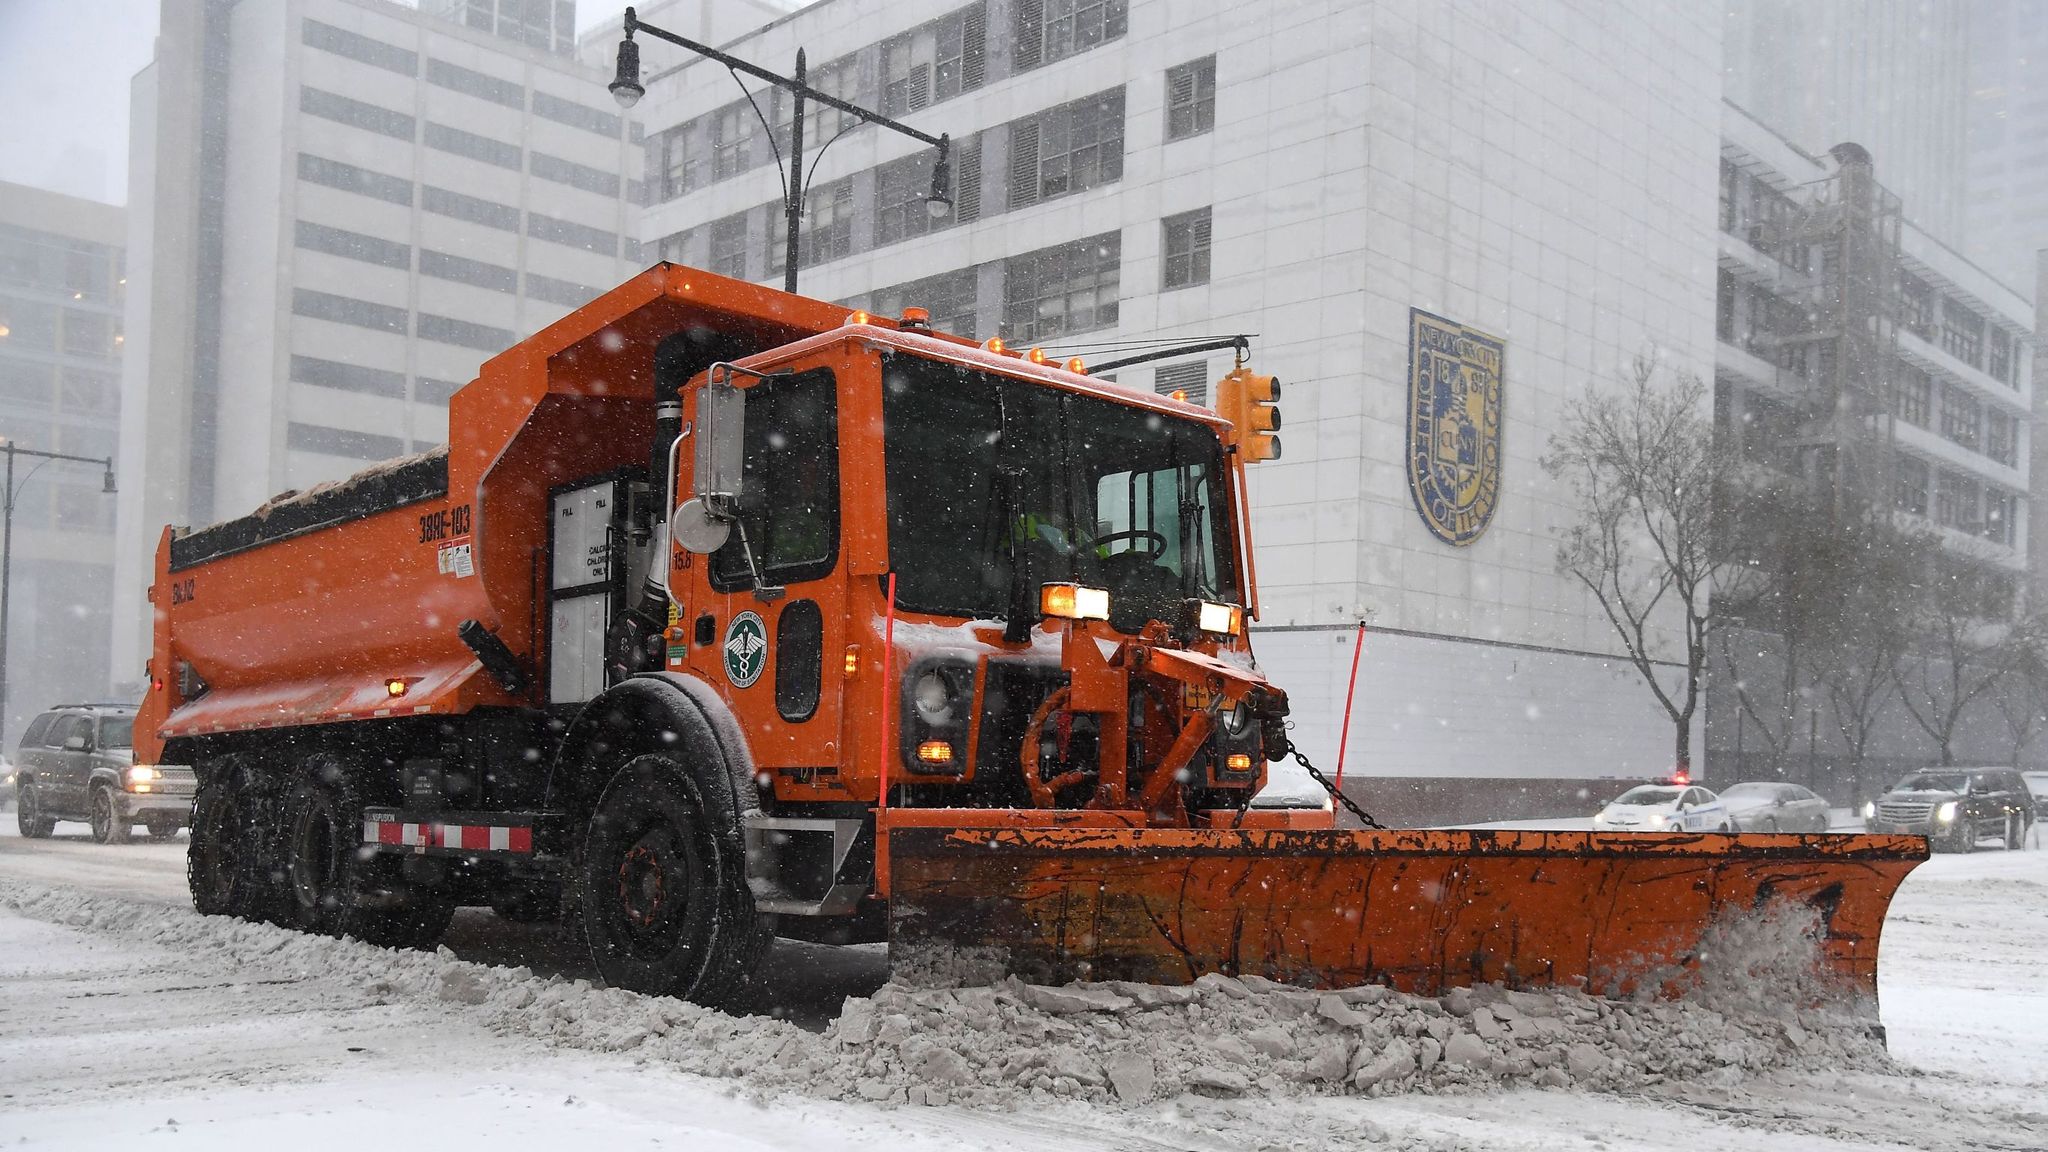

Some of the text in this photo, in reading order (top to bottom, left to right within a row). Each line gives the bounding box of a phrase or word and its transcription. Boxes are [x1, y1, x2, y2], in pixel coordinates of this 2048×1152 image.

[1420, 324, 1450, 354] NEW
[1477, 345, 1499, 370] CITY
[1437, 360, 1450, 384] 18
[1416, 346, 1499, 531] COLLEGE OF TECHNOLOGY
[1438, 430, 1475, 453] CUNY
[562, 507, 573, 517] FILL
[596, 499, 607, 509] FILL
[419, 504, 471, 544] 38AE-103
